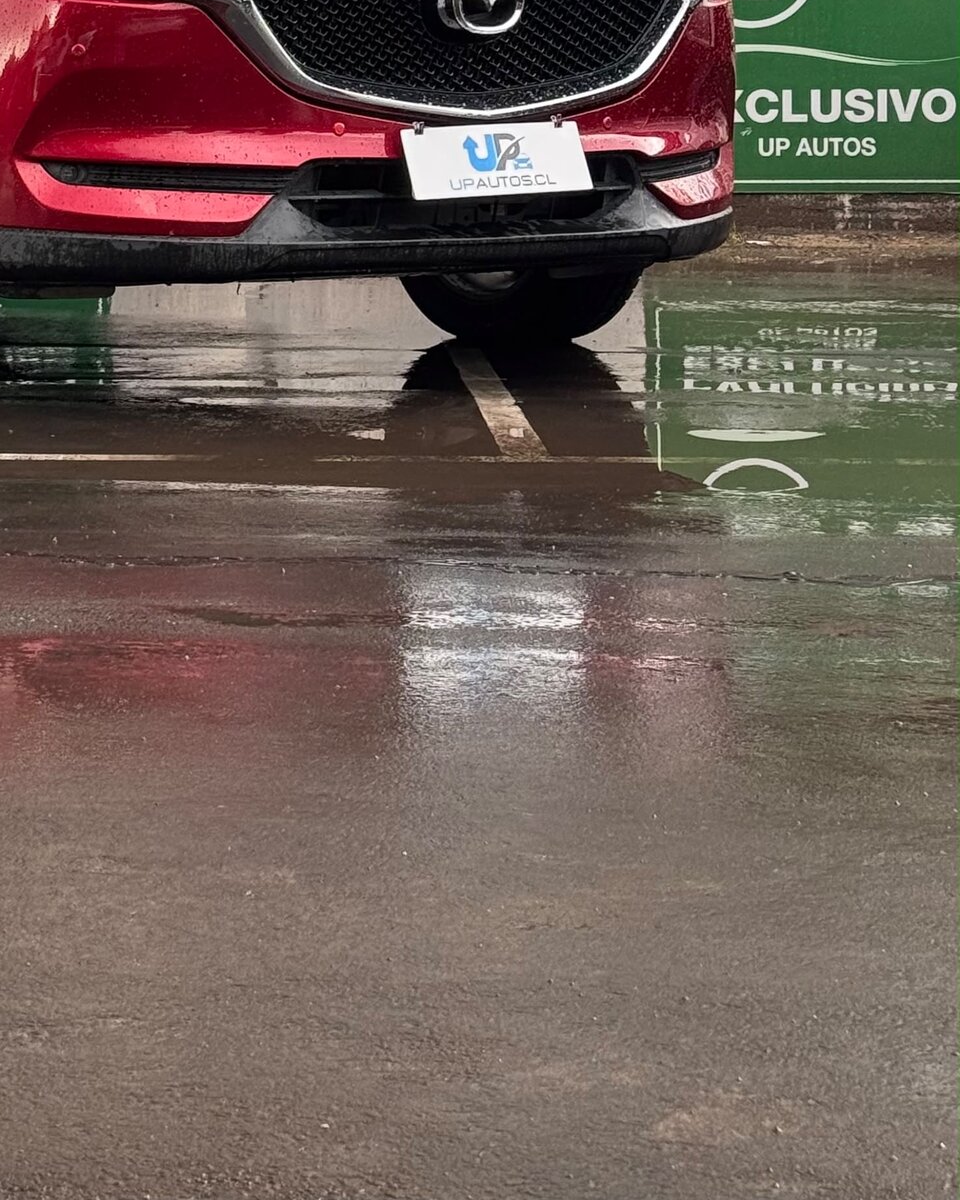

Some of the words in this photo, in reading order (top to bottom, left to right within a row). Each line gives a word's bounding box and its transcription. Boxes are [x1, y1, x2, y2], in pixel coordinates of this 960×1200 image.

[463, 133, 525, 172] UP
[758, 137, 791, 157] UP
[795, 136, 877, 157] AUTOS
[449, 174, 557, 191] UPAUTOS.CL
